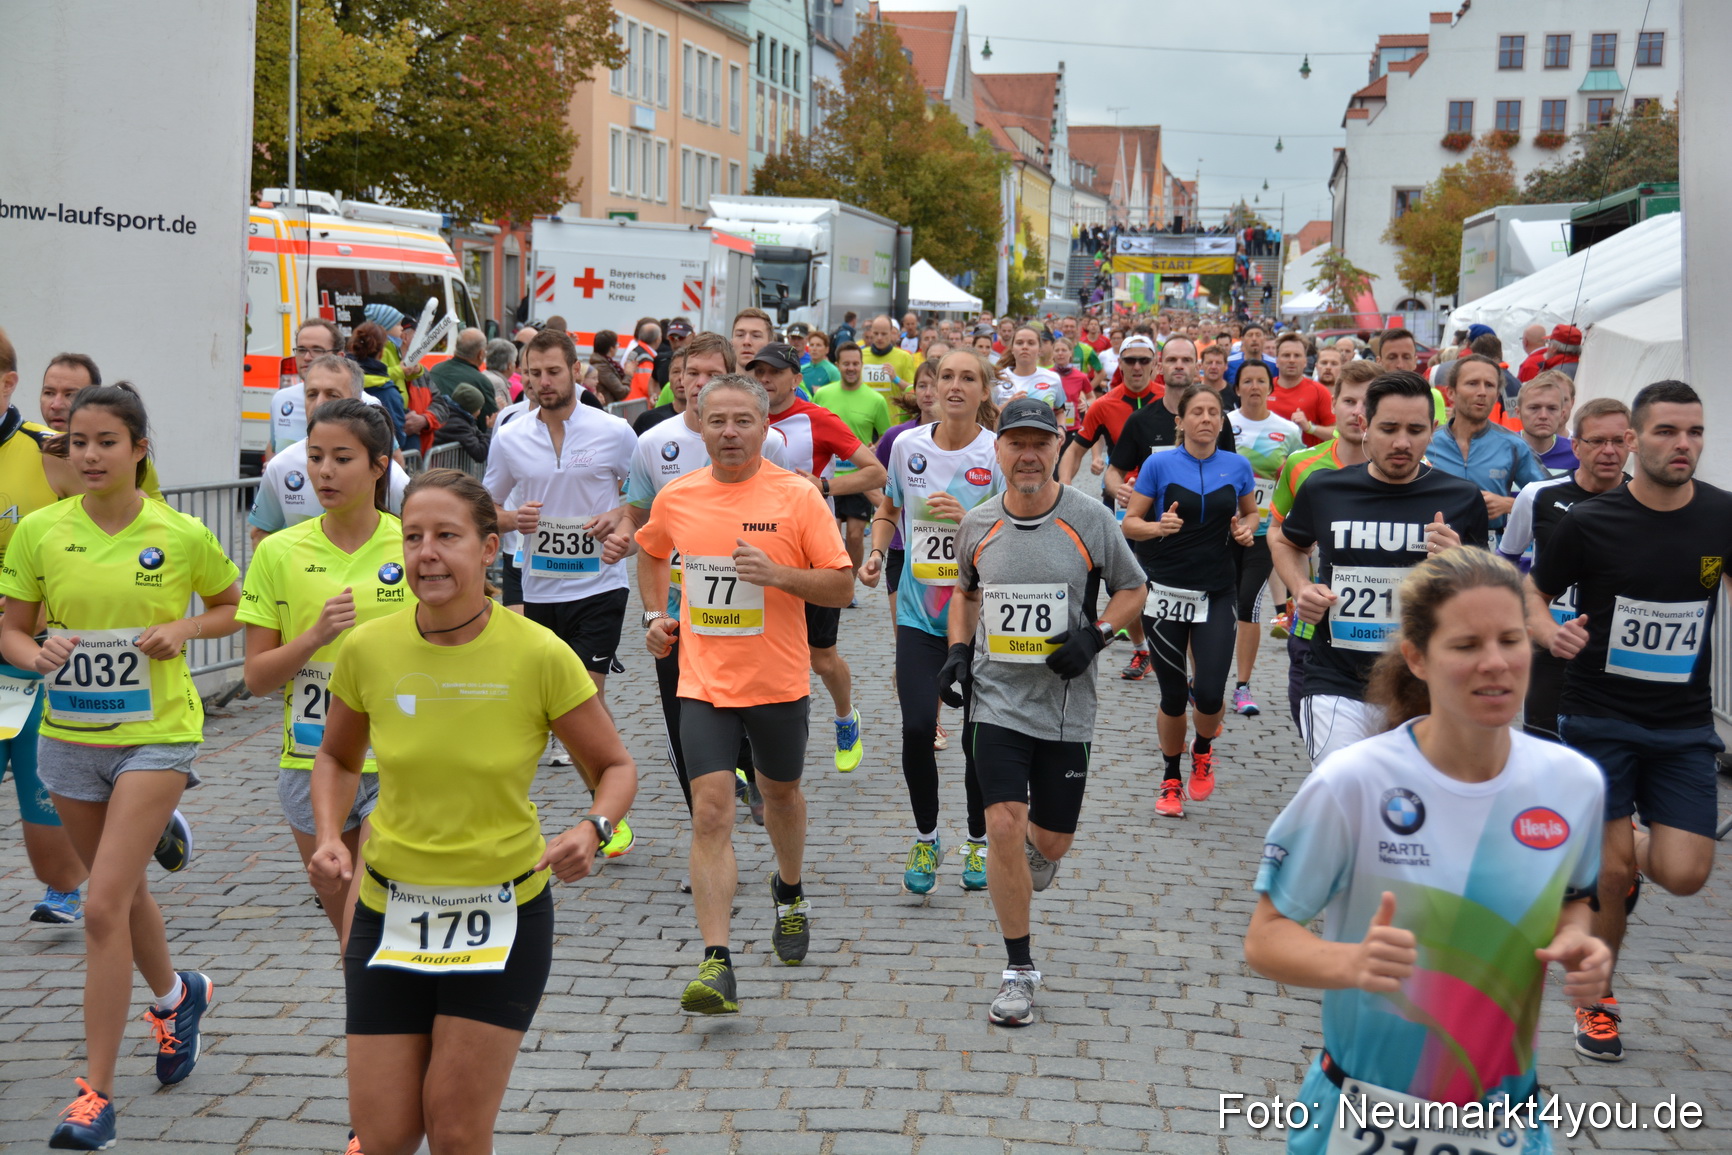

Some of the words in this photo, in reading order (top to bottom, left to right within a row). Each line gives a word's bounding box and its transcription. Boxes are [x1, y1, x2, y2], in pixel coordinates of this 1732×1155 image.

[0, 198, 197, 235] bmw-laufsport.de
[1151, 260, 1193, 270] START
[610, 268, 666, 280] Bayerisches
[609, 281, 636, 290] Rotes
[608, 293, 635, 302] Kreuz
[912, 300, 950, 308] Laufsport
[868, 371, 886, 381] 168
[1255, 490, 1263, 505] 0
[538, 521, 555, 529] ARTL
[742, 522, 778, 532] THULE
[538, 530, 595, 555] 2538
[927, 535, 956, 560] 26
[546, 559, 585, 570] Dominik
[685, 562, 707, 571] PARTL
[709, 564, 737, 572] Neuma
[135, 571, 163, 583] Partl
[938, 566, 959, 577] Sina
[1334, 573, 1362, 583] PARTL
[376, 587, 405, 597] Partl
[704, 575, 737, 605] 77
[984, 591, 1010, 600] PARTL
[1012, 592, 1053, 600] Neumarkt
[1168, 592, 1199, 601] Neumarkt
[1339, 586, 1394, 619] 221
[1156, 598, 1196, 623] 340
[1617, 604, 1650, 617] PARTL
[1651, 610, 1694, 619] Neumarkt
[702, 612, 740, 625] Oswald
[1000, 603, 1052, 632] 278
[1620, 618, 1697, 651] 3074
[78, 639, 128, 648] Neumarkt
[1009, 639, 1043, 652] Stefan
[54, 651, 140, 687] 2032
[69, 695, 126, 710] Vanessa
[1519, 818, 1564, 840] Hervis
[1379, 840, 1430, 857] PARTL
[1379, 855, 1431, 867] Neumarkt
[391, 890, 430, 905] PARTL
[432, 892, 493, 907] Neumarkt
[411, 909, 492, 951] 179
[410, 954, 472, 965] Andrea
